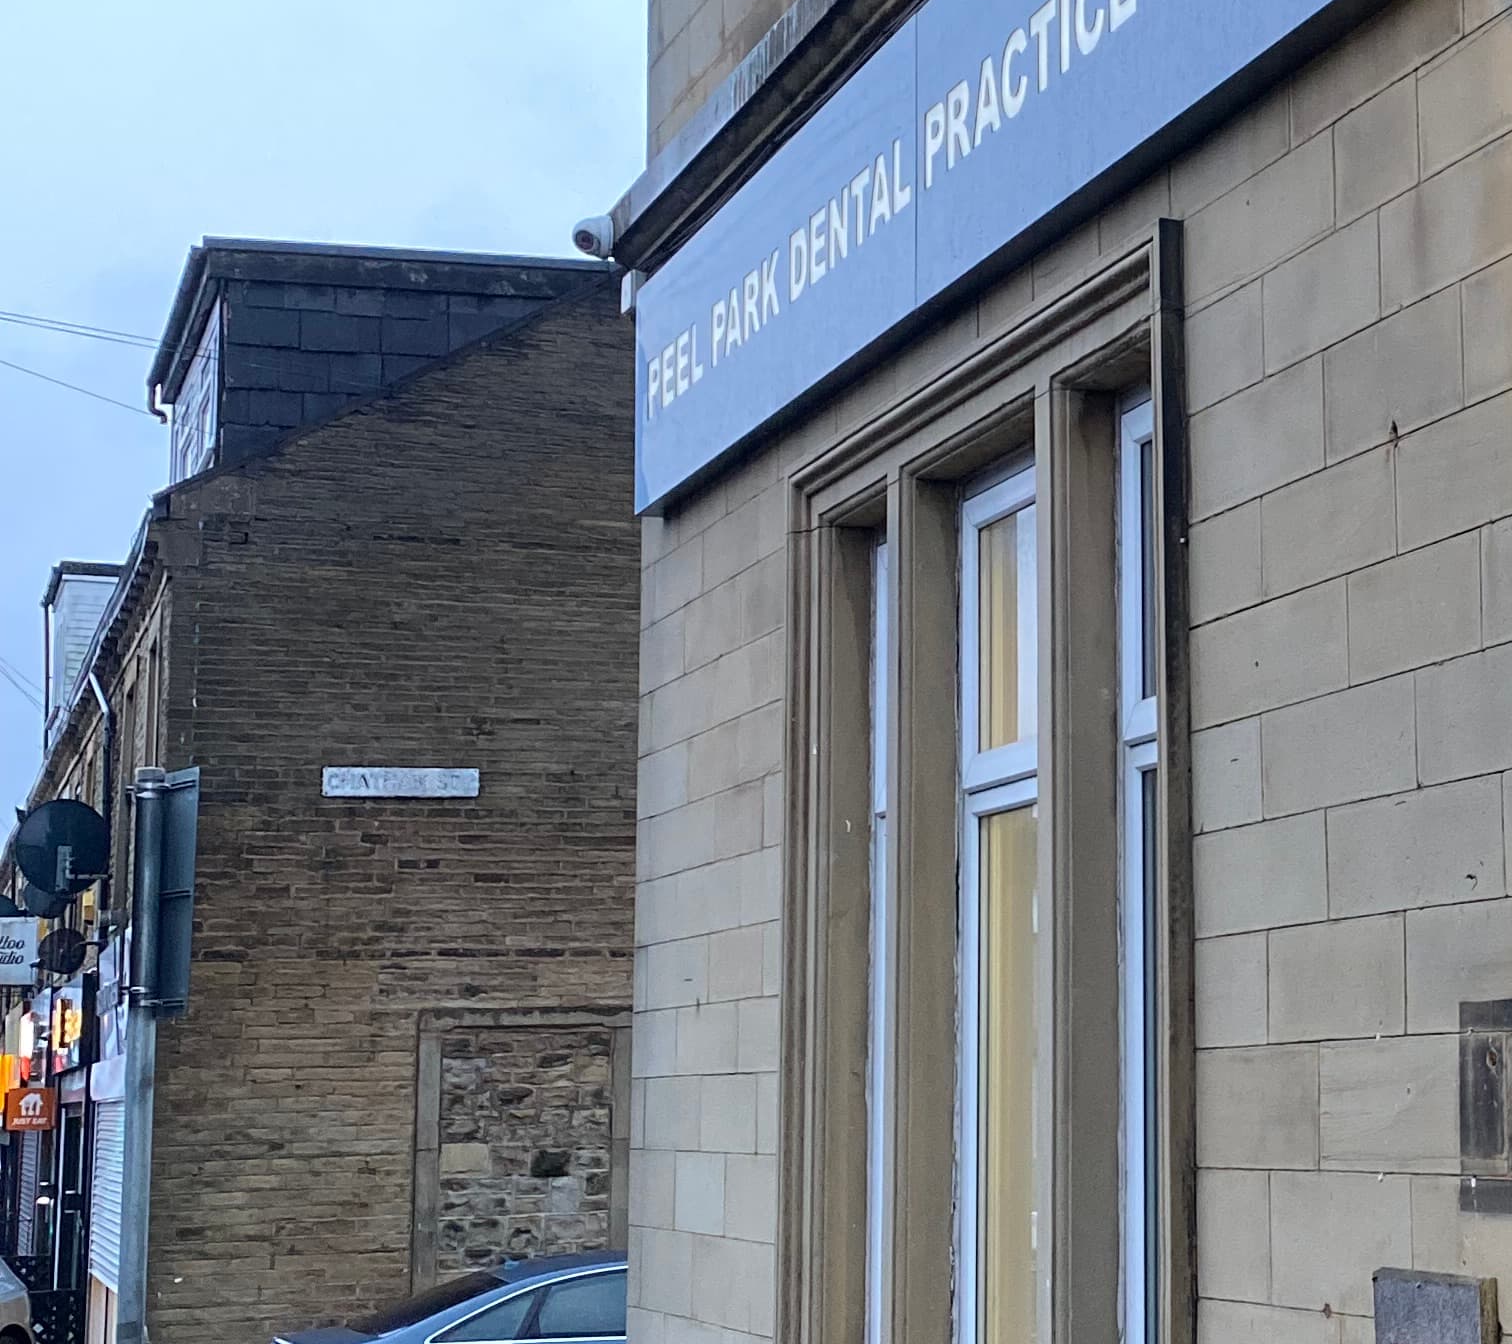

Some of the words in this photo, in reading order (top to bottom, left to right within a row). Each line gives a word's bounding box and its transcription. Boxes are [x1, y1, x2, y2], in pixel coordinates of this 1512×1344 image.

[647, 322, 704, 423] PEEL
[711, 247, 780, 369] PARK
[788, 138, 911, 305] DENTAL
